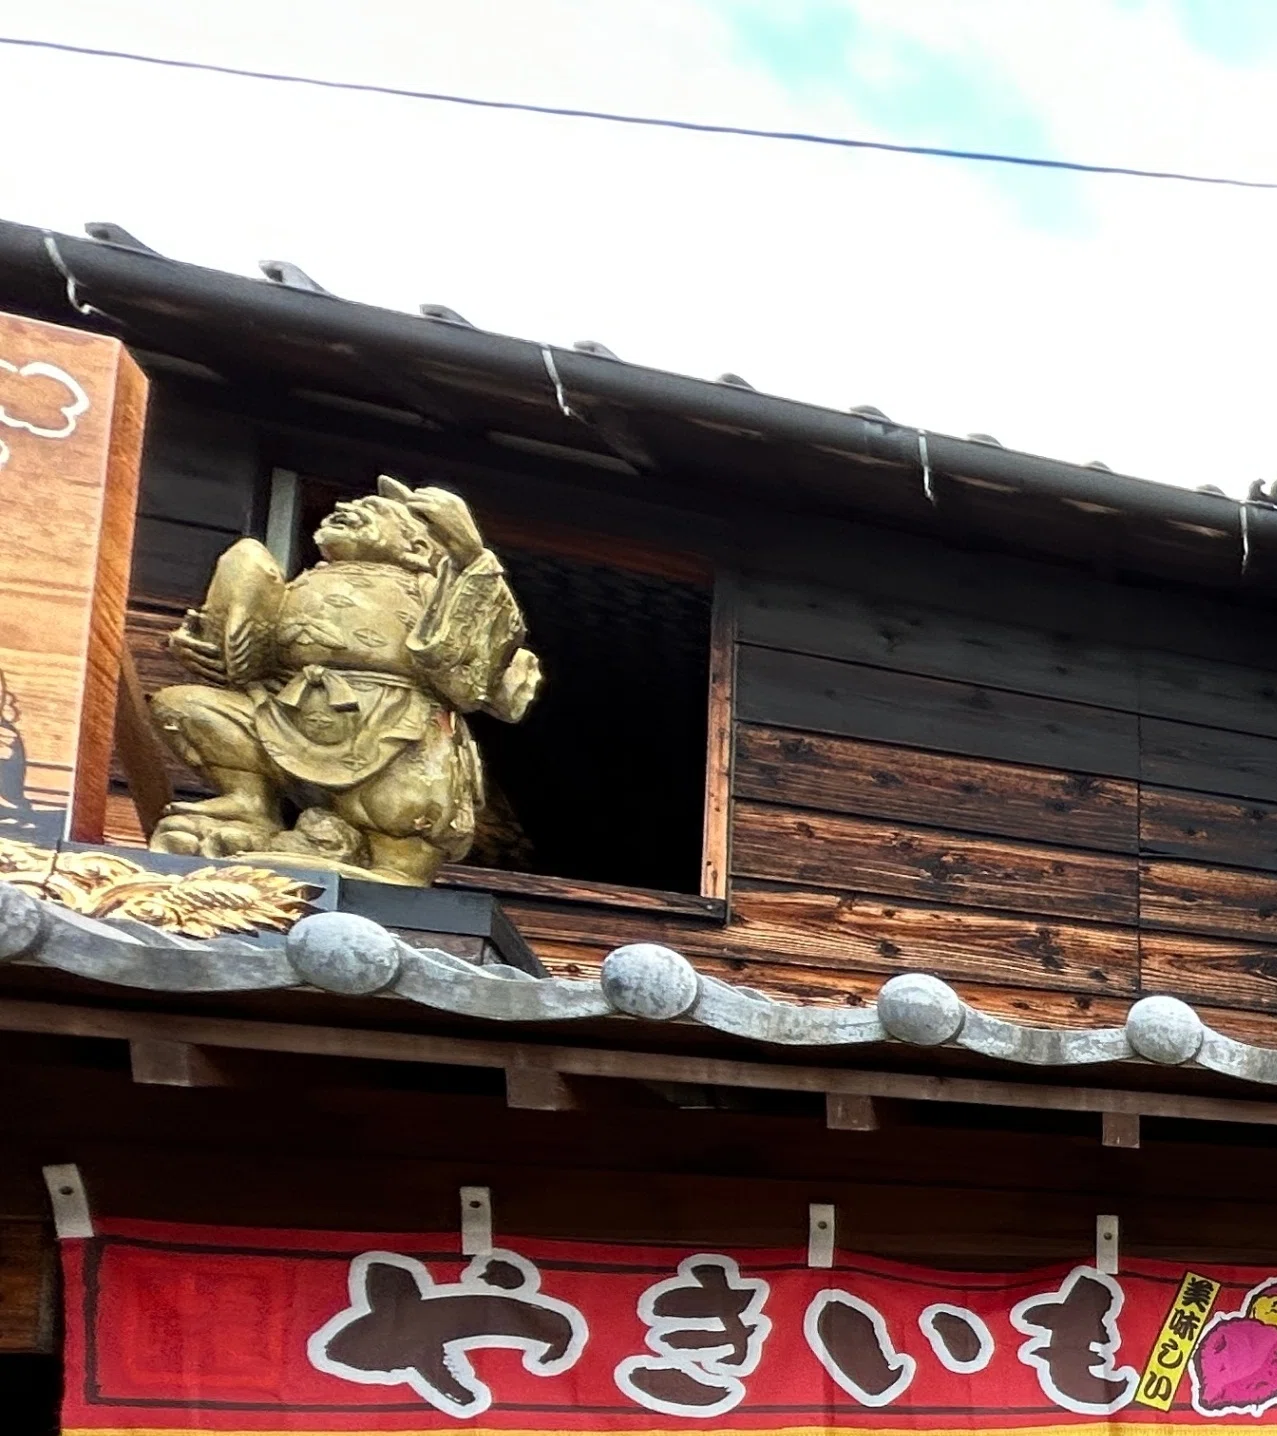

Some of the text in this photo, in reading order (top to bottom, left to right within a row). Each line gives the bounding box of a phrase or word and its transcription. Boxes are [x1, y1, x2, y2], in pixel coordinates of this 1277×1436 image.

[308, 1248, 1139, 1417] やきいも
[1143, 1276, 1214, 1401] 美味しい
